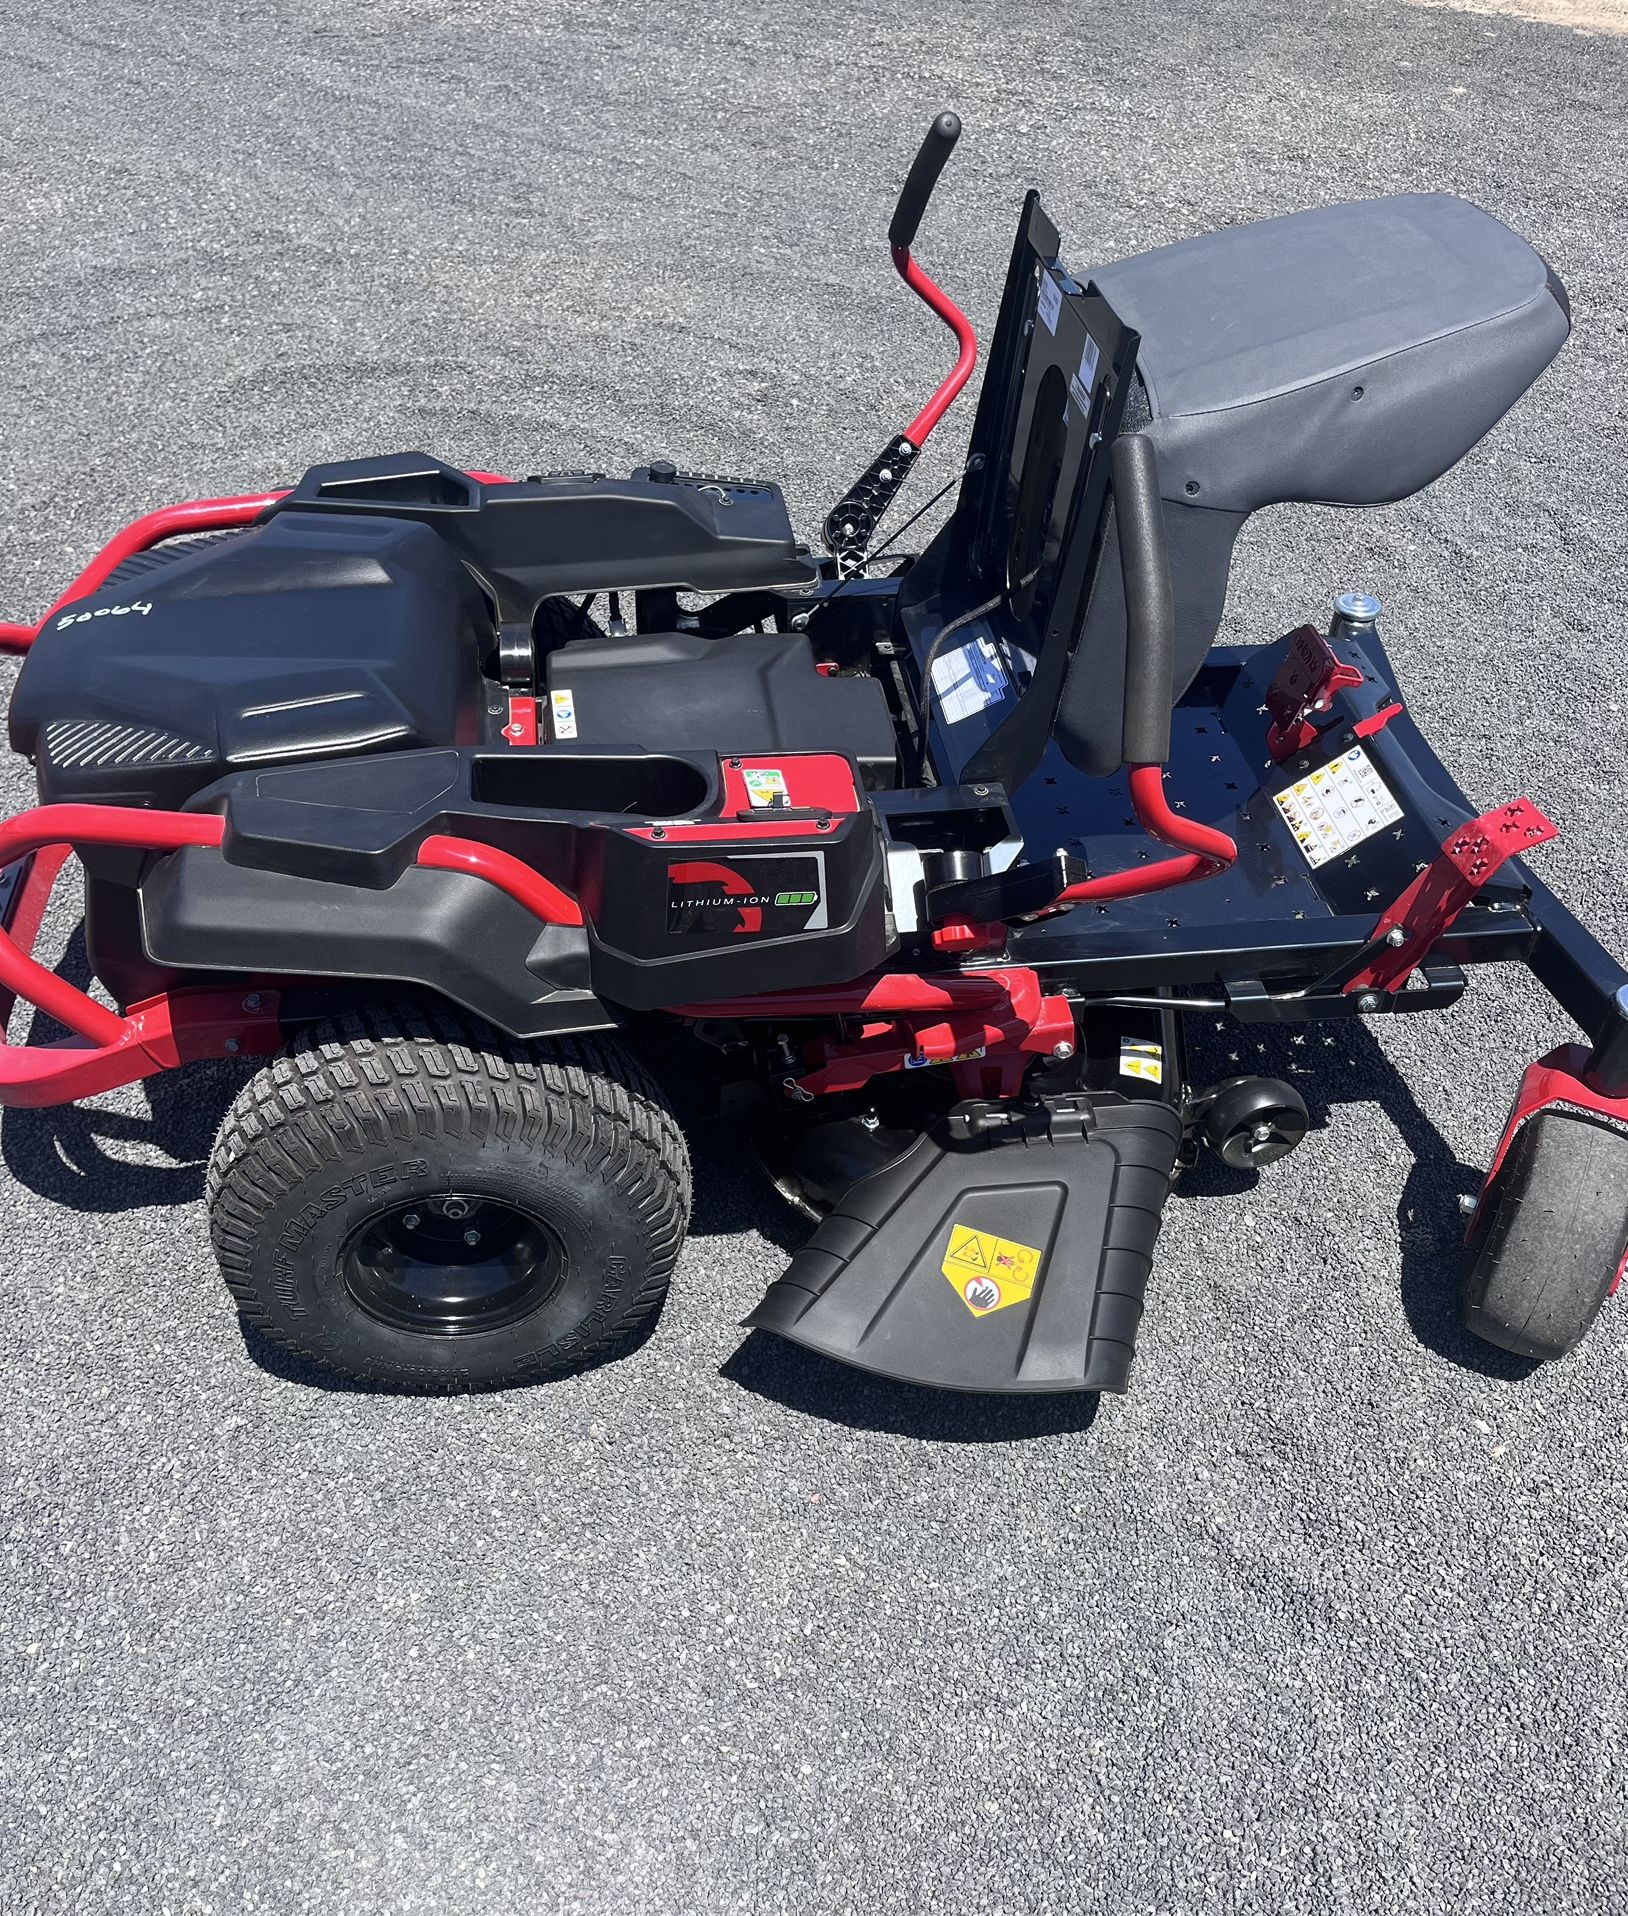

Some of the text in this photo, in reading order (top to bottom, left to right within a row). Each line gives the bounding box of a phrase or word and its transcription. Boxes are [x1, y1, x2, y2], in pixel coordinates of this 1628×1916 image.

[56, 600, 153, 631] 50064
[671, 896, 770, 908] LITHIUM-ION
[278, 1158, 428, 1252] MASTER
[272, 1248, 308, 1321] TURF
[513, 1255, 627, 1368] CARLISLE
